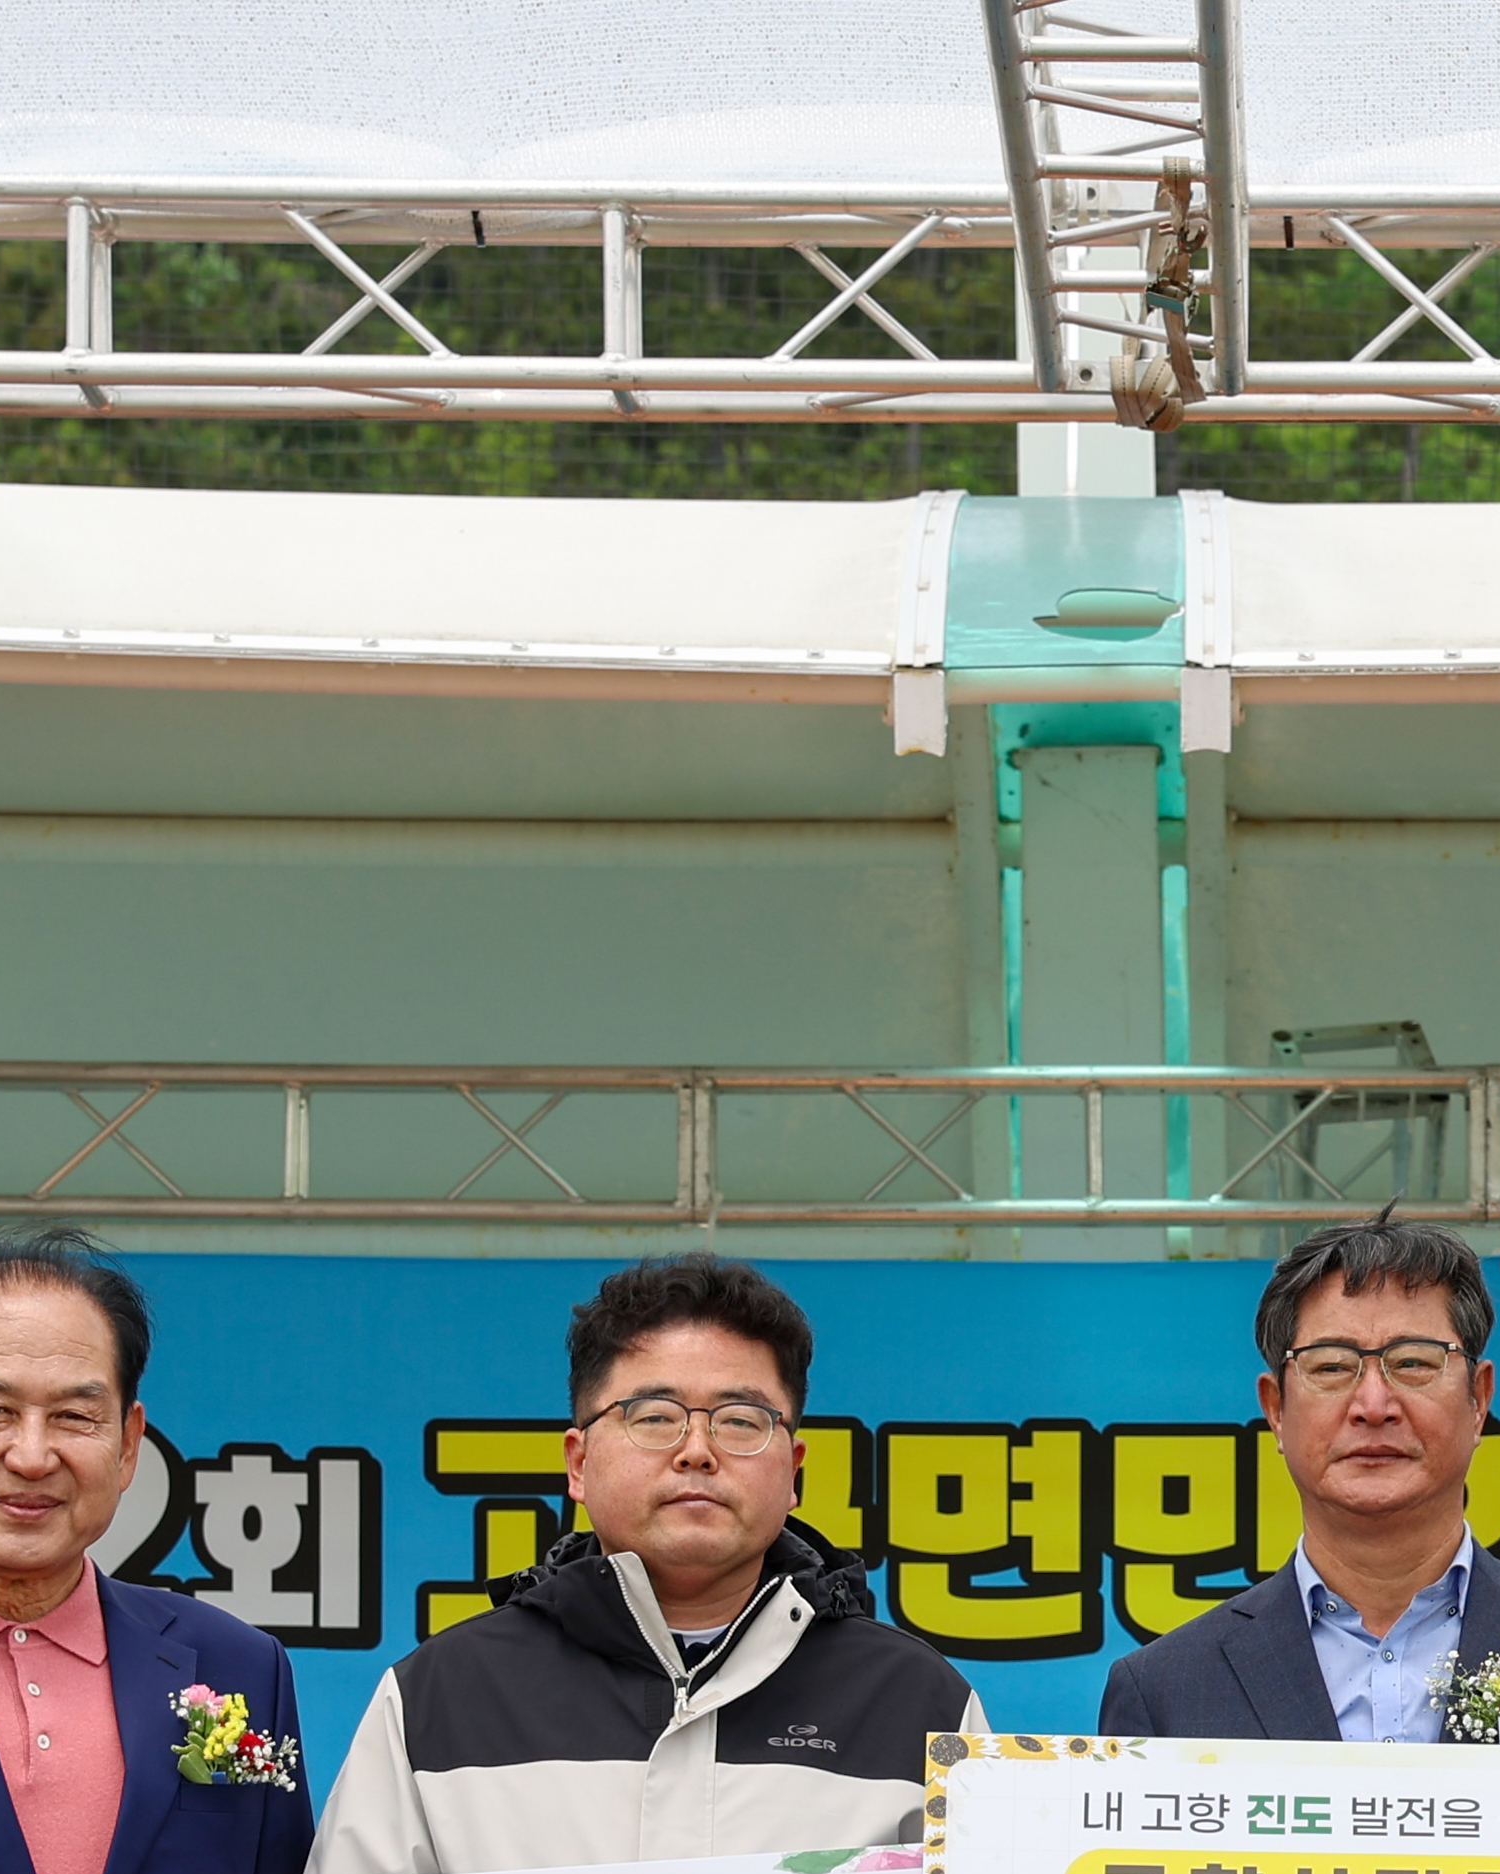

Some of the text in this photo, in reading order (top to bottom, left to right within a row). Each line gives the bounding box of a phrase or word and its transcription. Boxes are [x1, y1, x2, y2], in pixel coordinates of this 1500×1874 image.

[767, 1736, 837, 1753] EIDER
[1084, 1792, 1122, 1831] 내
[1142, 1793, 1230, 1833] 고향
[1247, 1796, 1332, 1834] 진도
[1352, 1798, 1482, 1837] 발전을
